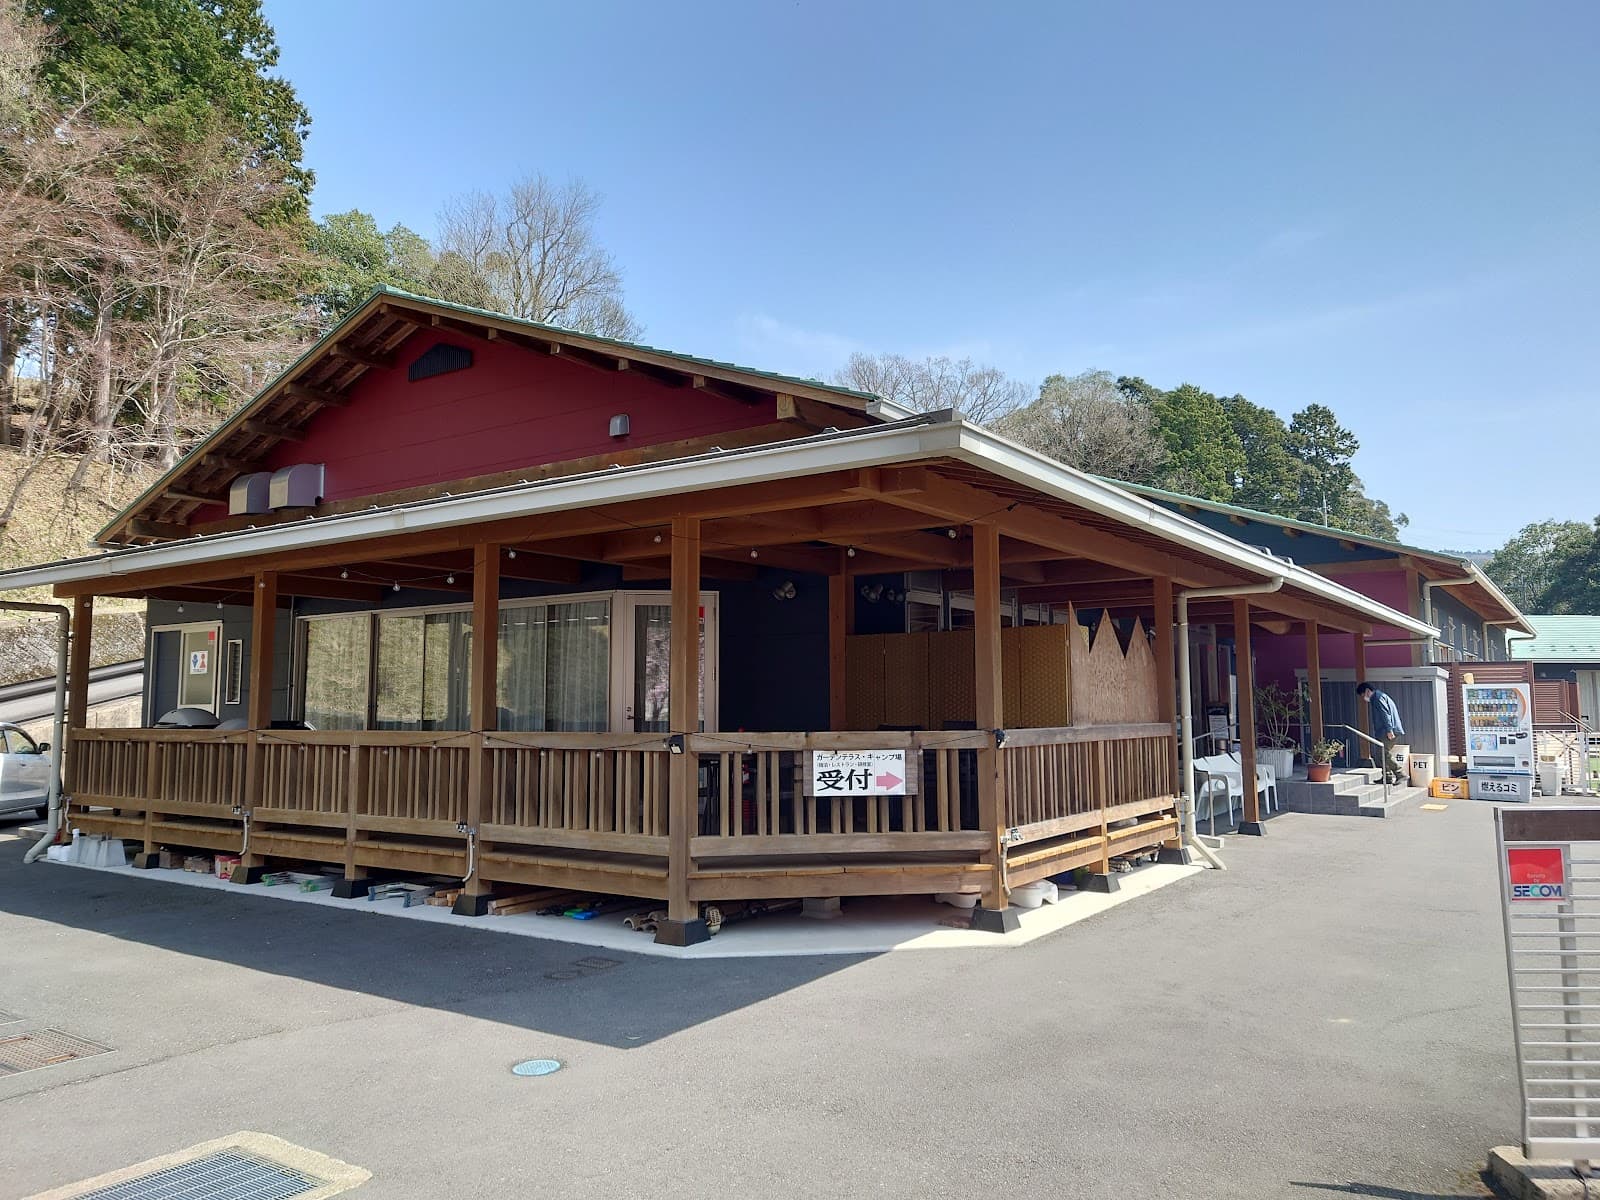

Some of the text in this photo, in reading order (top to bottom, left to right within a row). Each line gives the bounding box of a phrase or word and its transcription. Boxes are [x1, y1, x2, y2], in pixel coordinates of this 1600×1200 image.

[1413, 761, 1427, 769] PET
[816, 768, 873, 792] 受付
[1513, 885, 1562, 897] SECOM
